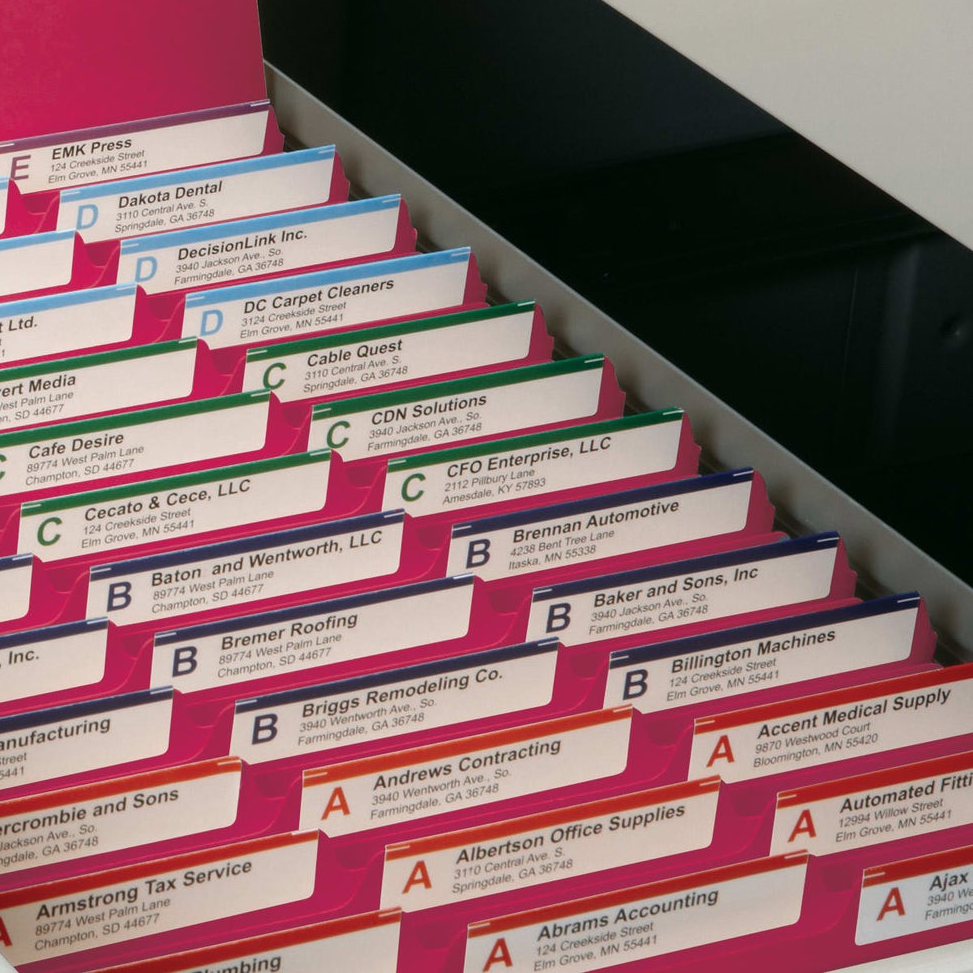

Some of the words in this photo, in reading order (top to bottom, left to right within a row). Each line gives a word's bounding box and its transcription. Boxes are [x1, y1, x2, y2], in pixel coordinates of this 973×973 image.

[50, 143, 87, 160] EMK
[89, 138, 133, 153] Press
[117, 191, 171, 208] Dakota
[173, 180, 223, 199] Dental
[76, 205, 98, 230] D
[115, 210, 139, 220] 3110
[140, 203, 174, 216] Central
[168, 214, 184, 223] GA
[185, 208, 215, 220] 36748
[176, 231, 277, 260] DecisionLink
[280, 229, 308, 242] Inc.
[243, 298, 268, 313] DC
[270, 289, 323, 309] Carpet
[326, 279, 395, 299] Cleaners
[7, 315, 38, 331] Ltd.
[306, 348, 352, 367] Cable
[354, 339, 403, 361] Quest
[27, 374, 77, 393] Media
[27, 442, 67, 459] Cafe
[70, 433, 125, 452] Desire
[446, 459, 483, 478] CFO
[486, 446, 574, 470] Enterprise,
[578, 436, 613, 454] LLC
[401, 473, 426, 502] C
[444, 479, 469, 491] 2112
[509, 469, 535, 479] Lane
[497, 483, 513, 494] KY
[514, 477, 546, 491] 57893
[83, 501, 143, 522] Cecato
[147, 495, 161, 510] &
[164, 489, 212, 506] Cece,
[216, 478, 252, 497] LLC
[512, 520, 582, 543] Brennan
[585, 501, 680, 528] Automotive
[150, 567, 202, 587] Baton
[210, 556, 244, 575] and
[247, 538, 344, 568] Wentworth,
[348, 529, 384, 549] LLC
[592, 589, 642, 607] Baker
[645, 579, 678, 598] and
[681, 573, 729, 591] Sons,
[732, 567, 759, 581] Inc
[220, 628, 285, 650] Bremer
[288, 614, 359, 637] Roofing
[7, 649, 40, 665] Inc.
[172, 646, 197, 677] B
[218, 649, 253, 664] 89774
[254, 644, 283, 657] West
[284, 639, 313, 651] Palm
[315, 634, 343, 645] Lane
[278, 654, 296, 666] SD
[298, 647, 332, 661] 44677
[670, 647, 752, 673] Billington
[755, 630, 837, 656] Machines
[301, 696, 361, 717] Briggs
[364, 674, 470, 705] Remodeling
[474, 668, 504, 683] Co.
[757, 714, 818, 739] Accent
[821, 699, 888, 725] Medical
[891, 687, 952, 711] Supply
[706, 735, 735, 767] A
[754, 739, 782, 753] 9870
[784, 727, 839, 747] Westwood
[841, 721, 871, 735] Court
[823, 740, 843, 752] MN
[845, 732, 879, 748] 55420
[373, 763, 453, 790] Andrews
[456, 739, 562, 772] Contracting
[91, 796, 127, 817] and
[131, 788, 180, 809] Sons
[839, 779, 936, 813] Automated
[455, 835, 545, 864] Albertson
[548, 822, 603, 844] Office
[607, 804, 687, 831] Supplies
[36, 886, 139, 920] Armstrong
[143, 878, 177, 896] Tax
[181, 860, 253, 887] Service
[537, 914, 610, 941] Abrams
[613, 889, 720, 924] Accounting
